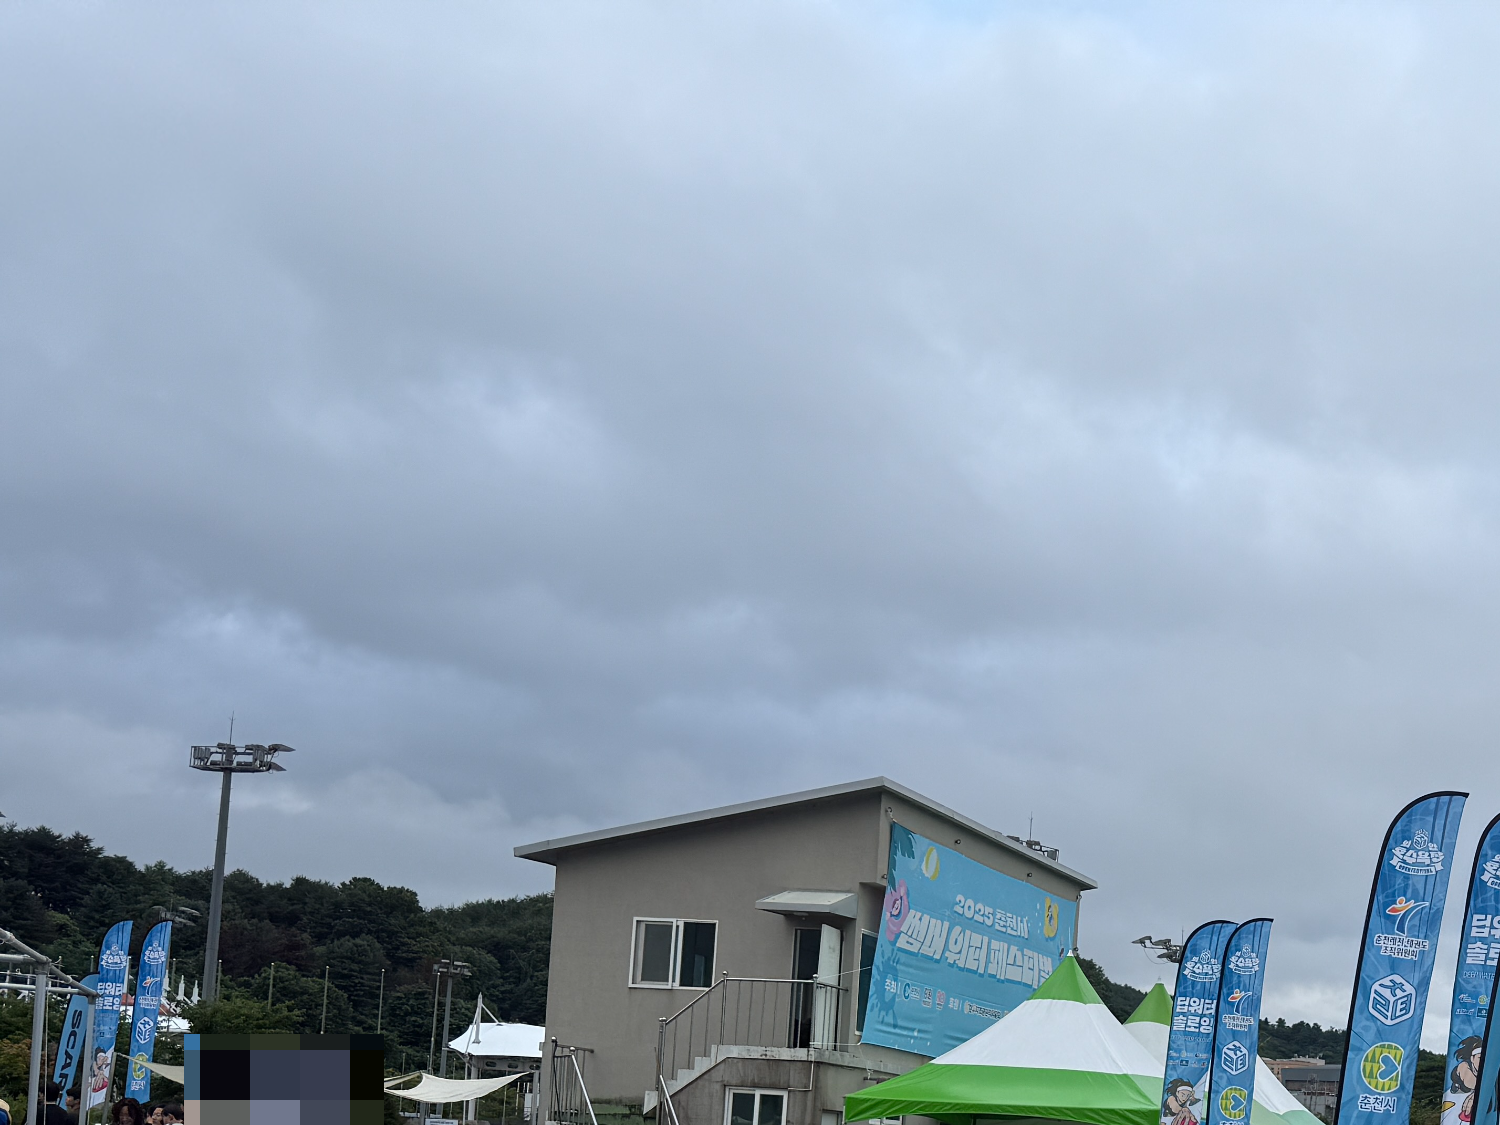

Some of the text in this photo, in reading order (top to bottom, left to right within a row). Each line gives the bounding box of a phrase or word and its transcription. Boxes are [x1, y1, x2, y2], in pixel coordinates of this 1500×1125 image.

[953, 894, 994, 925] 2025
[896, 909, 949, 959] 썸머
[945, 925, 989, 974] 워터
[1176, 997, 1217, 1016] 딥워터
[1173, 1015, 1215, 1034] 솔로잉
[1359, 1095, 1397, 1113] 춘천시
